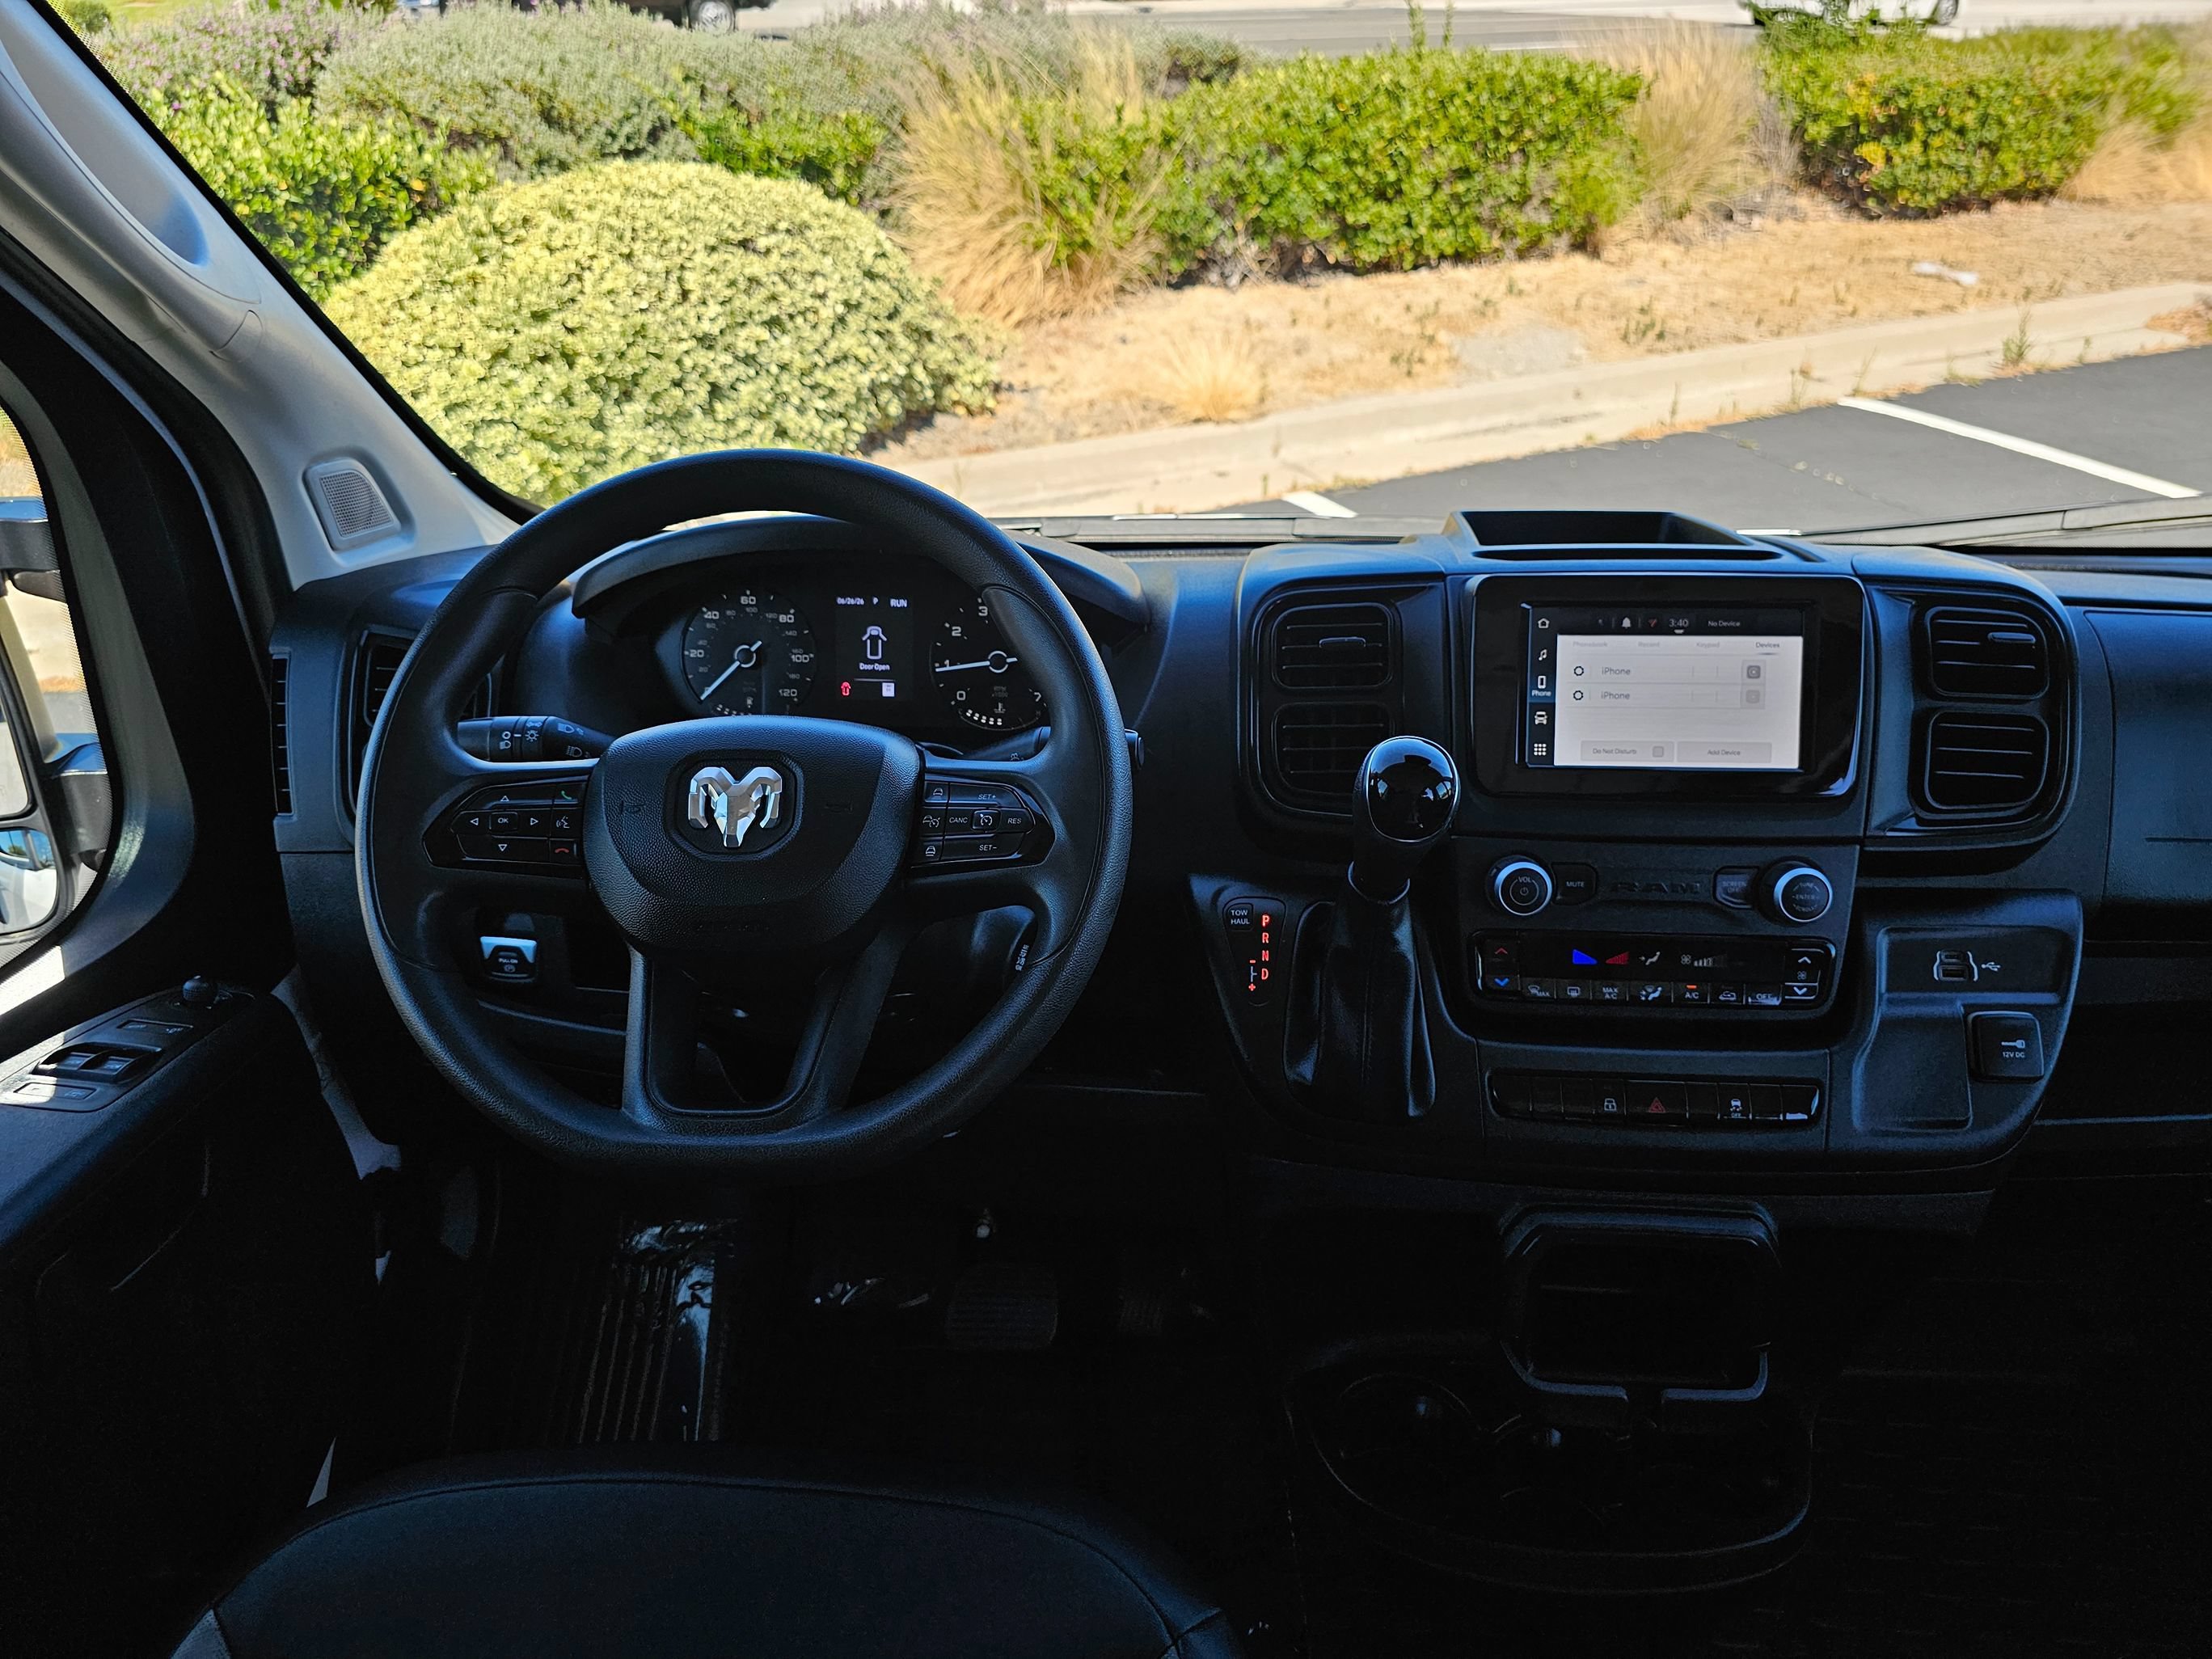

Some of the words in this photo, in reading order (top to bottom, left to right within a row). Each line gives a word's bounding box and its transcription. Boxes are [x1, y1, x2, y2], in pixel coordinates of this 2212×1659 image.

[740, 596, 756, 605] 60
[872, 597, 879, 605] P
[890, 598, 908, 608] RUN
[703, 611, 720, 619] 40
[978, 606, 989, 617] 3
[779, 614, 795, 623] 80
[1669, 618, 1690, 628] 3:40
[1708, 619, 1718, 627] No
[1719, 619, 1741, 627] Device
[951, 626, 962, 636] 2
[1696, 641, 1720, 650] Keypad
[690, 650, 705, 658] 20
[791, 655, 810, 663] 100
[859, 662, 874, 671] Door
[875, 663, 891, 672] Open
[1601, 665, 1631, 676] iPhone
[779, 689, 798, 697] 120
[956, 690, 967, 701] 0
[1531, 690, 1551, 698] Phone
[1601, 690, 1630, 700] iPhone
[1615, 747, 1637, 755] Disturb
[497, 817, 509, 825] OK
[1262, 914, 1270, 927] P
[1262, 932, 1269, 943] R
[1262, 950, 1269, 961] N
[1261, 968, 1269, 980] D
[1684, 991, 1700, 999] A/C
